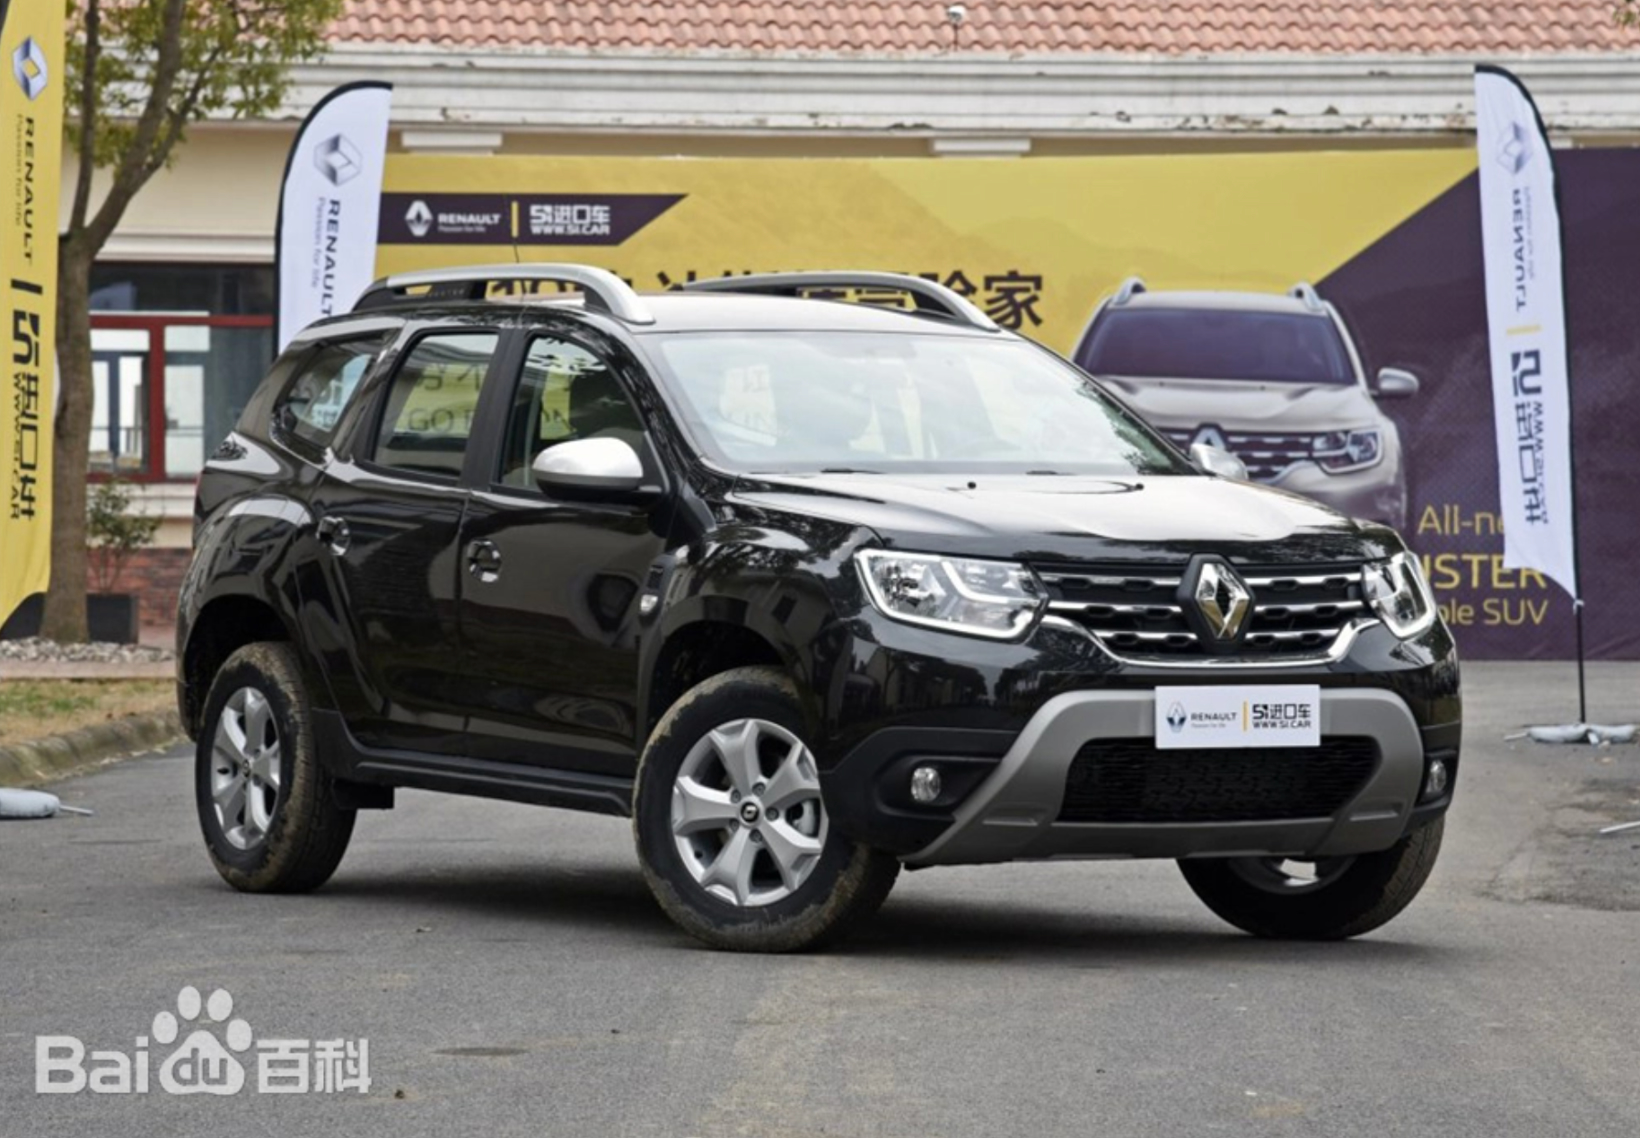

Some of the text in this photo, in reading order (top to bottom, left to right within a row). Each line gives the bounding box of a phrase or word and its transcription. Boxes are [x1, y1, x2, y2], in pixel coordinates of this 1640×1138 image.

[23, 116, 35, 265] RENAULT
[438, 213, 501, 225] RENAULT
[312, 248, 321, 266] for
[320, 199, 341, 317] RENAULT
[310, 267, 320, 289] life
[1483, 599, 1549, 625] SUV
[1190, 711, 1237, 721] RENAULT
